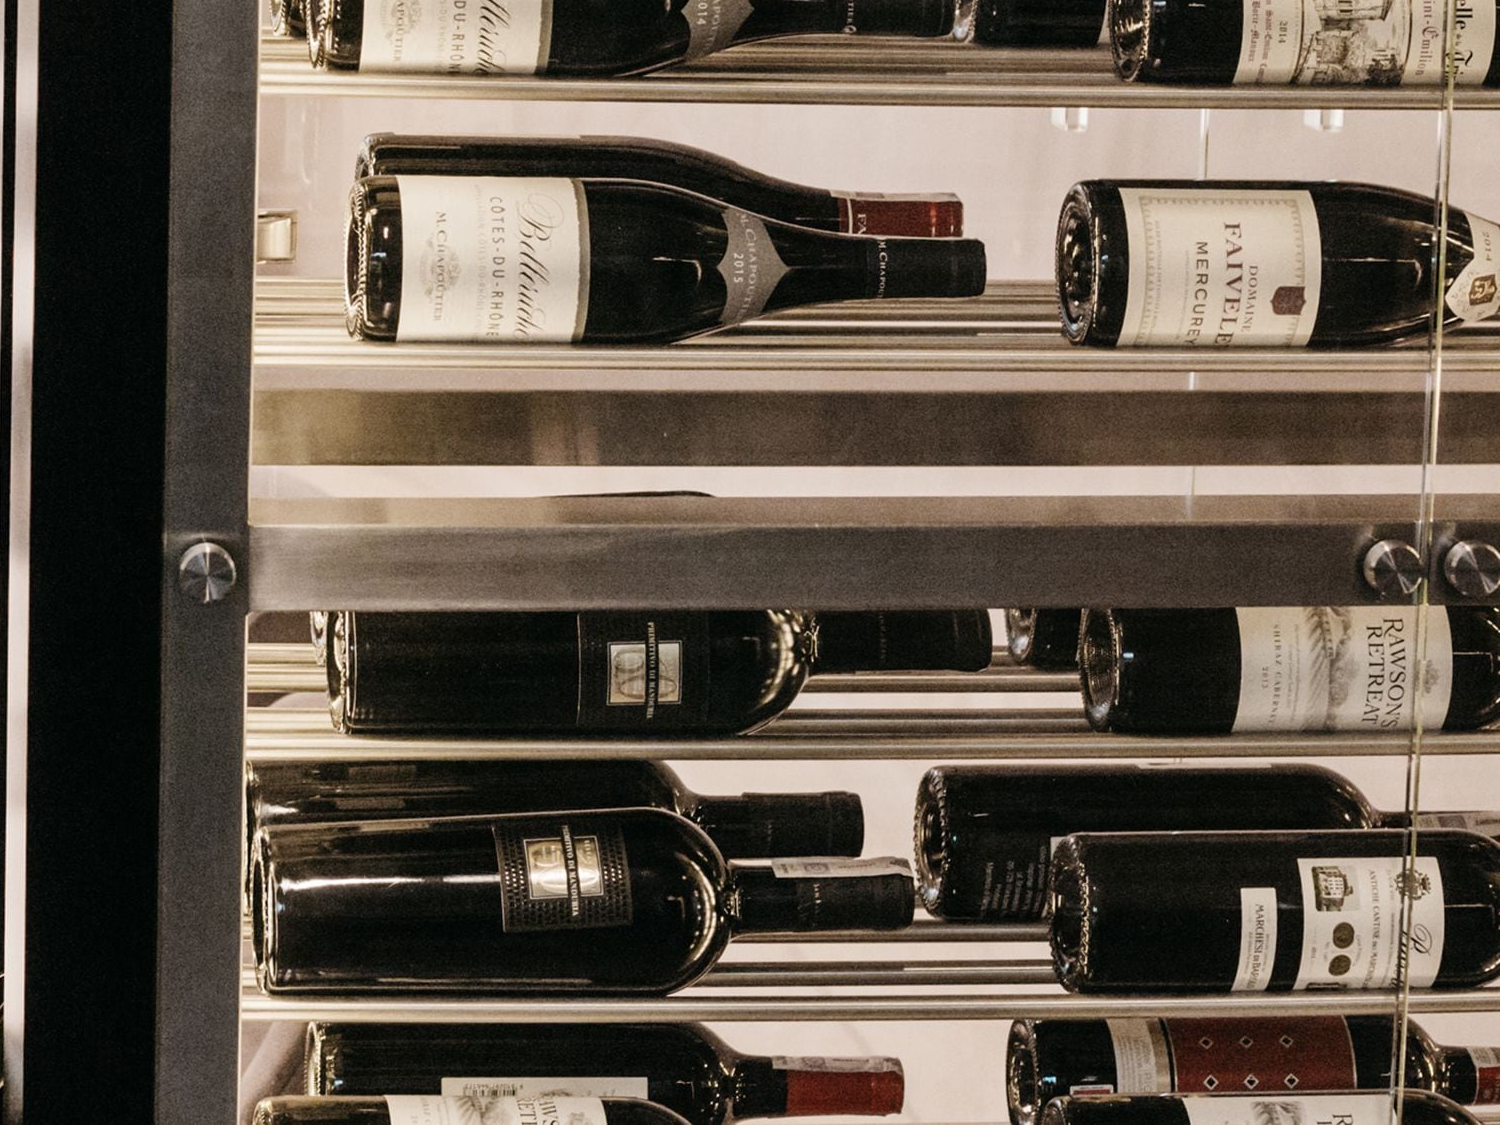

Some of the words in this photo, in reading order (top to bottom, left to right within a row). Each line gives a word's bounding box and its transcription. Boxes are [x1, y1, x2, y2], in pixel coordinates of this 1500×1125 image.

[1277, 20, 1288, 44] 2014
[433, 229, 447, 321] CHAPOUTIER
[485, 196, 506, 337] CÔTES-DU-RHÔNE
[733, 253, 744, 283] 2015
[1182, 241, 1209, 346] MERCUREY
[1240, 265, 1259, 332] DOMAINE
[647, 621, 656, 668] PRIMITIVO
[1272, 624, 1283, 666] SHIRAZ
[1267, 671, 1283, 726] CABERNET
[1361, 625, 1385, 725] RETREAT
[1379, 617, 1406, 729] RAWSON'S
[568, 870, 580, 917] MANDURIA
[1368, 869, 1380, 903] ANTICHE
[1254, 903, 1265, 954] MARCHESI
[1372, 905, 1381, 940] CANTINE
